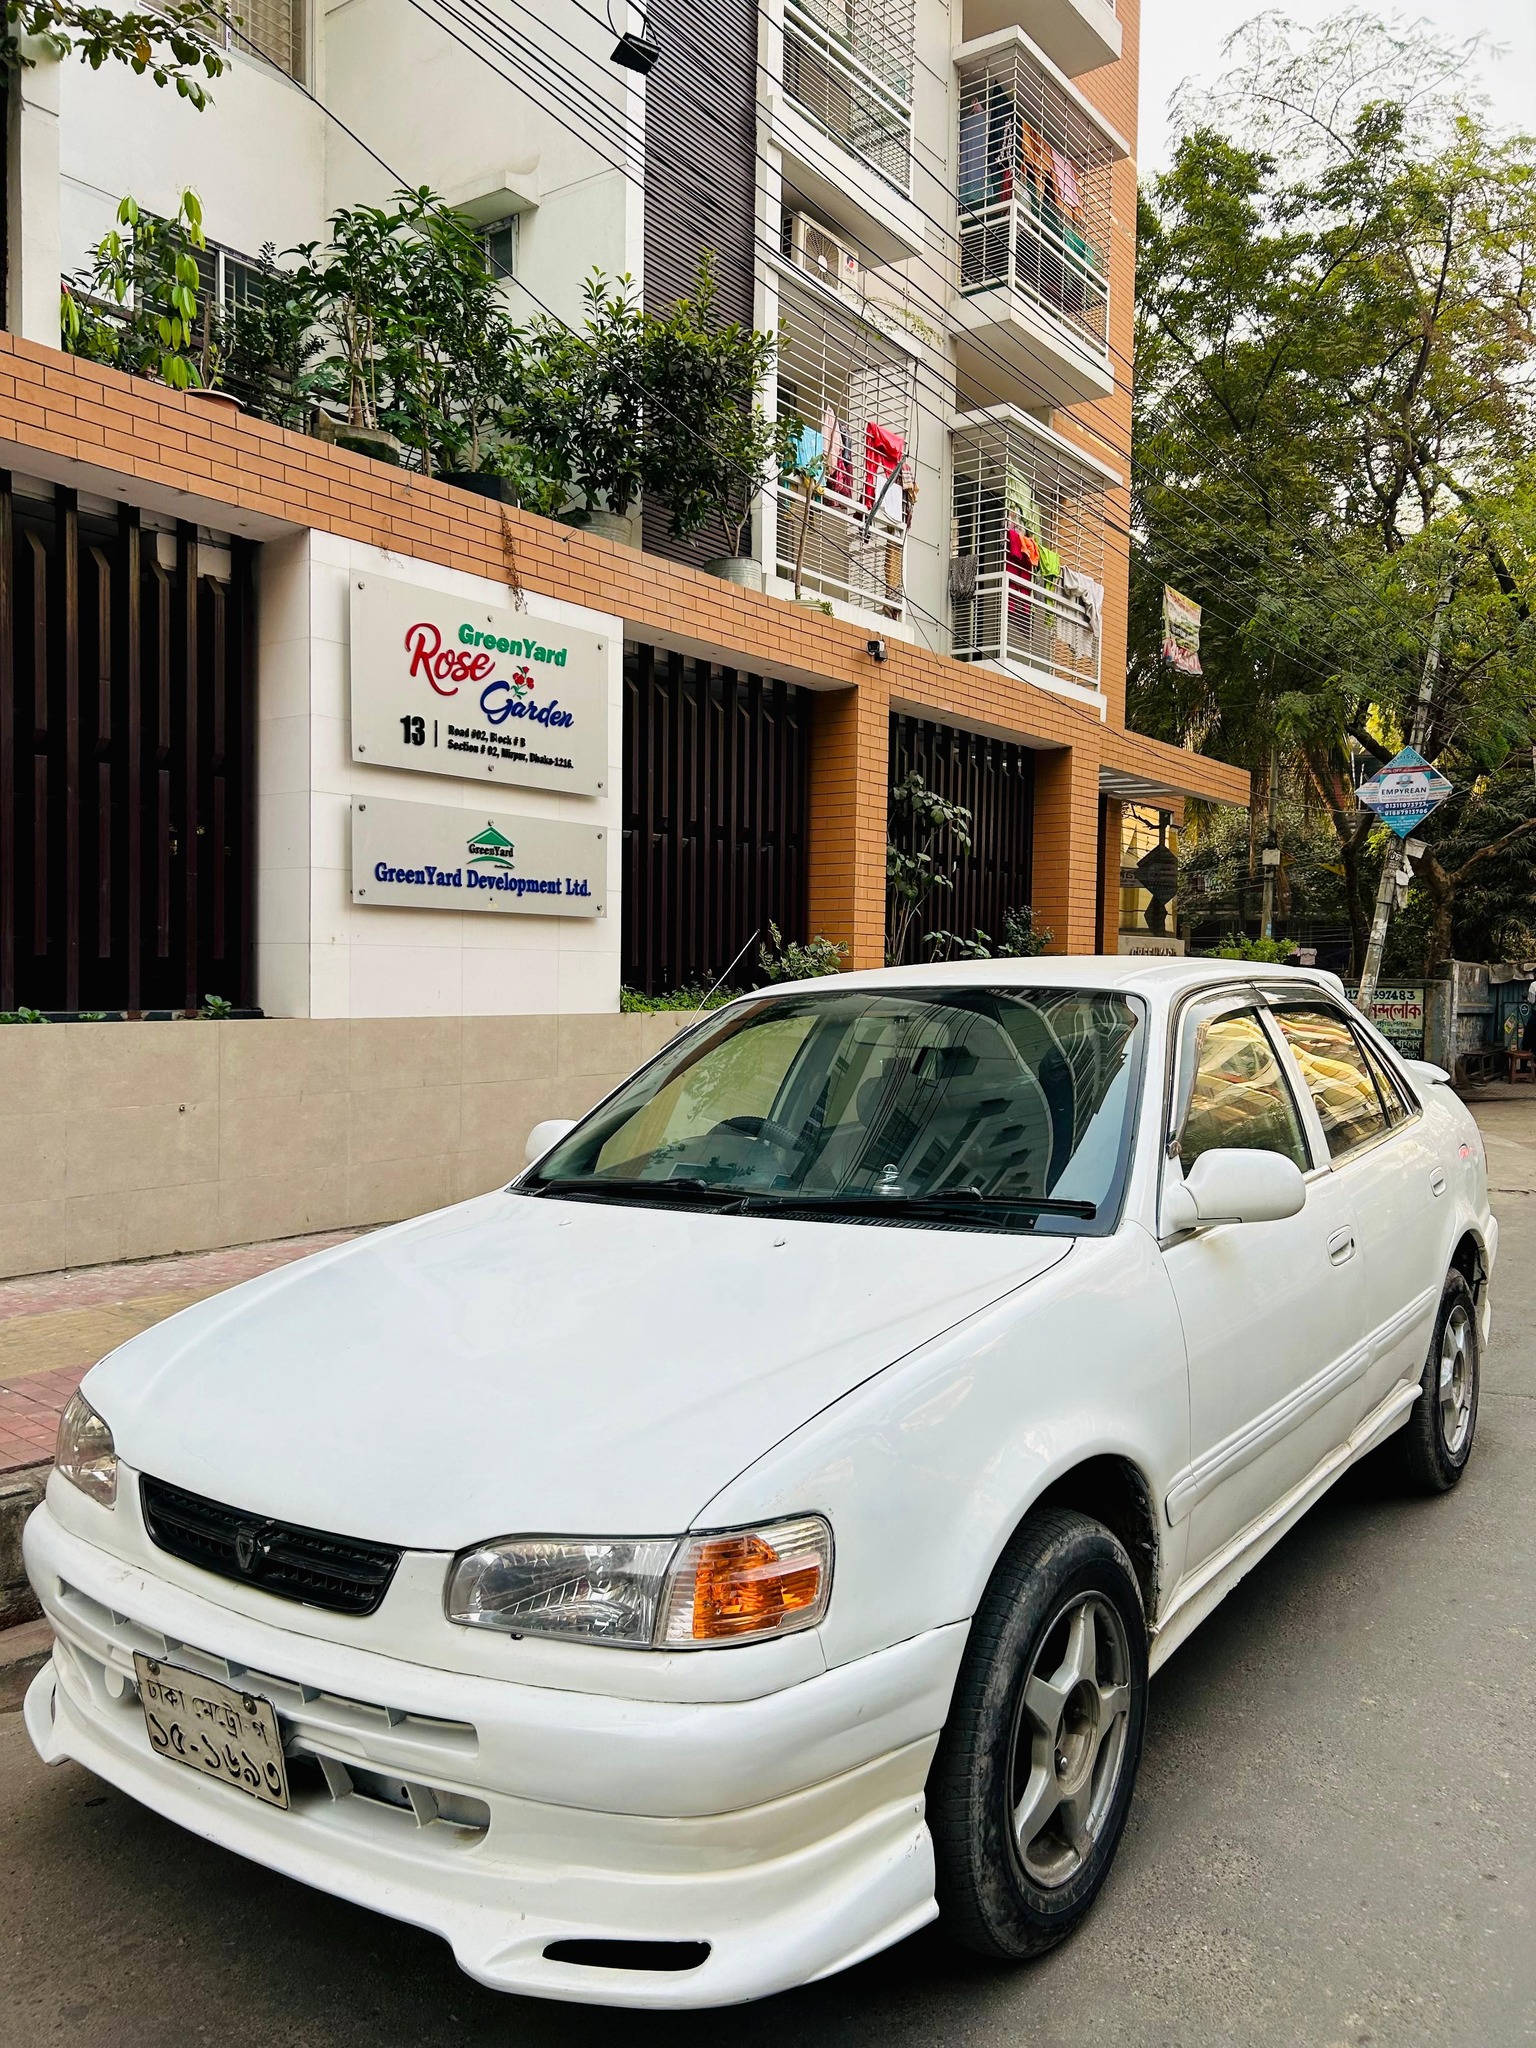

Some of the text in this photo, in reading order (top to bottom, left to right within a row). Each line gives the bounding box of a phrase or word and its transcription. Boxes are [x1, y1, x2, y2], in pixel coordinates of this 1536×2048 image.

[405, 622, 496, 697] Rose
[458, 623, 568, 667] GreenYard
[479, 680, 574, 728] Garden
[400, 715, 426, 746] 13
[448, 724, 470, 738] Road
[490, 732, 512, 745] Block
[520, 737, 526, 748] B
[447, 739, 479, 754] Section
[487, 746, 500, 759] 02,
[501, 748, 528, 762] Mirpur,
[1381, 787, 1427, 795] EMPYREAN
[468, 843, 514, 858] GreenYard
[375, 862, 592, 897] GreenYard Development Ltd.
[147, 1678, 187, 1712] ঢাকা
